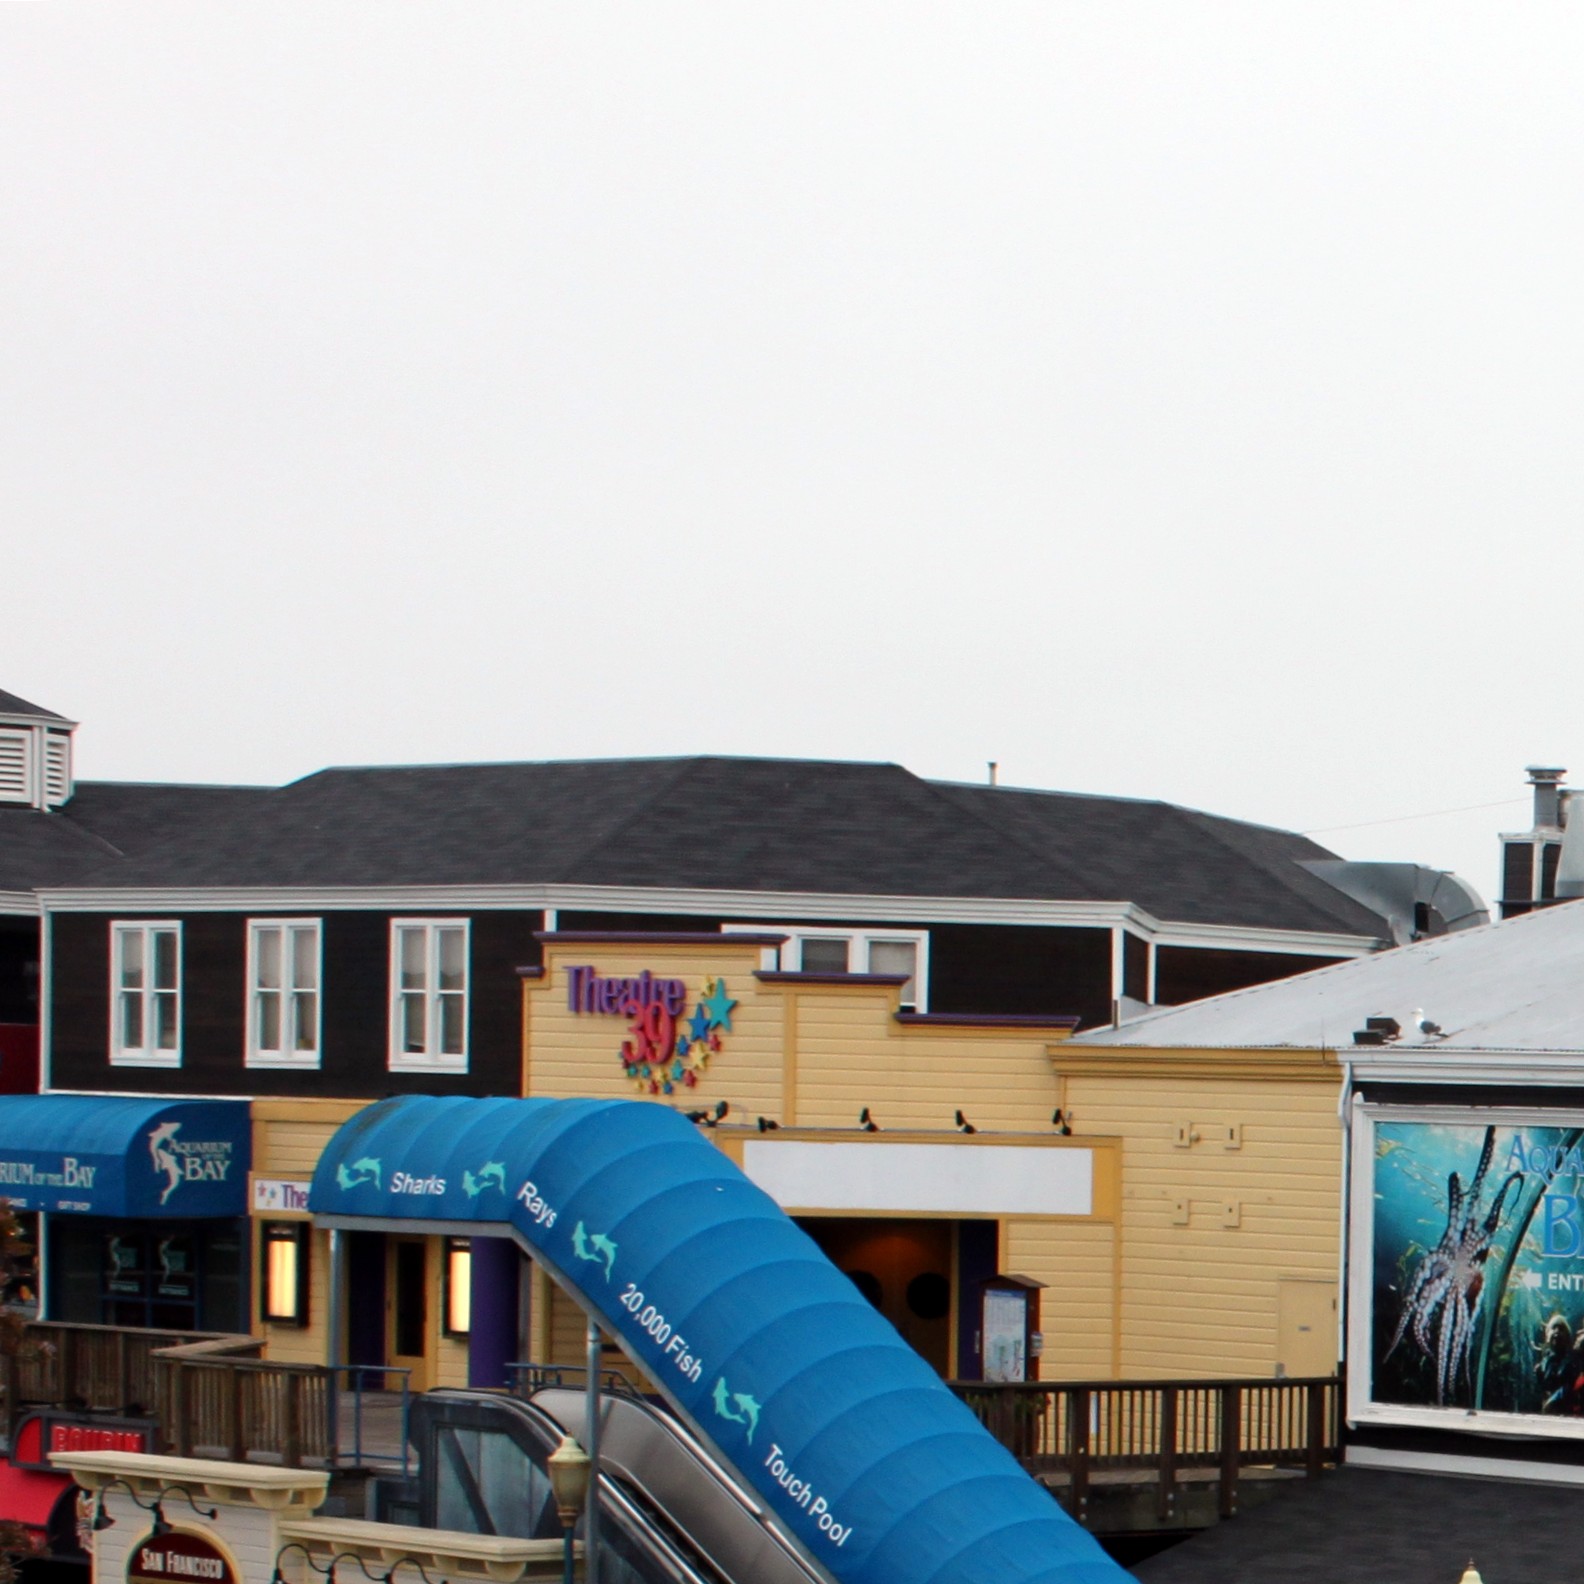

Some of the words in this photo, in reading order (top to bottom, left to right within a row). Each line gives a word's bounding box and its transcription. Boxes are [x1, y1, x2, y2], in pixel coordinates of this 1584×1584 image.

[562, 964, 686, 1015] Theatre
[621, 999, 676, 1064] 39
[168, 1139, 232, 1156] AQUARIUM
[63, 1157, 96, 1189] BAY
[184, 1157, 231, 1181] BAY
[390, 1172, 447, 1196] Sharks
[516, 1181, 559, 1229] Rays
[619, 1283, 672, 1345] 20,000
[664, 1334, 703, 1384] Fish
[763, 1443, 812, 1508] Touch
[809, 1496, 853, 1547] Pool
[142, 1547, 164, 1572] SAN
[166, 1550, 224, 1580] FRANCISCO
